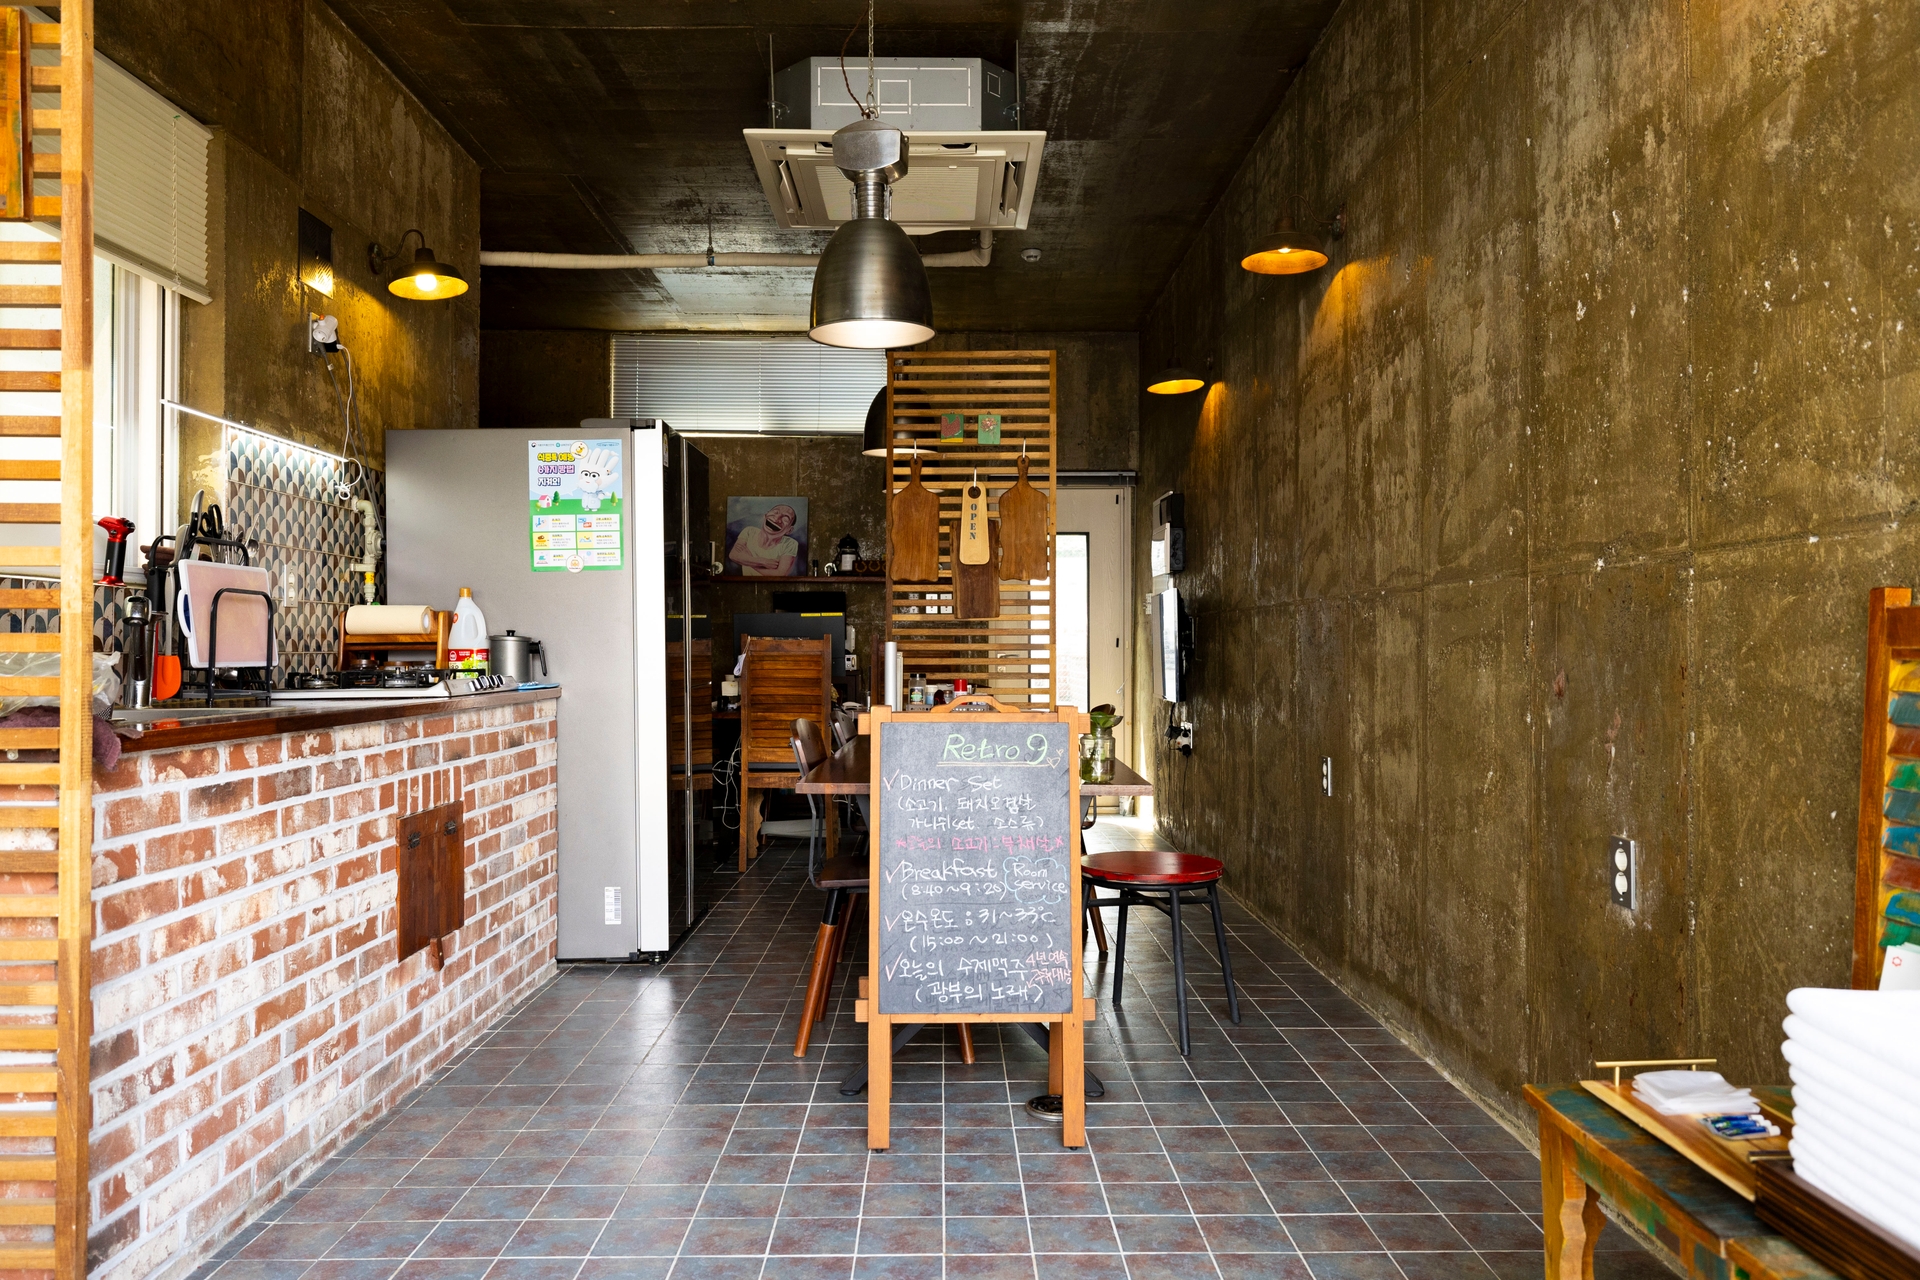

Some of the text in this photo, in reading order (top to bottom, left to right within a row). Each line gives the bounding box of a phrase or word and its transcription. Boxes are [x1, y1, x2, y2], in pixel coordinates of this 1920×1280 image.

[970, 503, 978, 540] OPEN
[943, 733, 1048, 765] Retro 9
[900, 774, 1003, 792] Dinner Set
[900, 858, 998, 882] Breakfast
[1012, 862, 1047, 877] Room
[901, 908, 958, 933] 온수온도
[899, 957, 1029, 981] 오늘의 수제맥주
